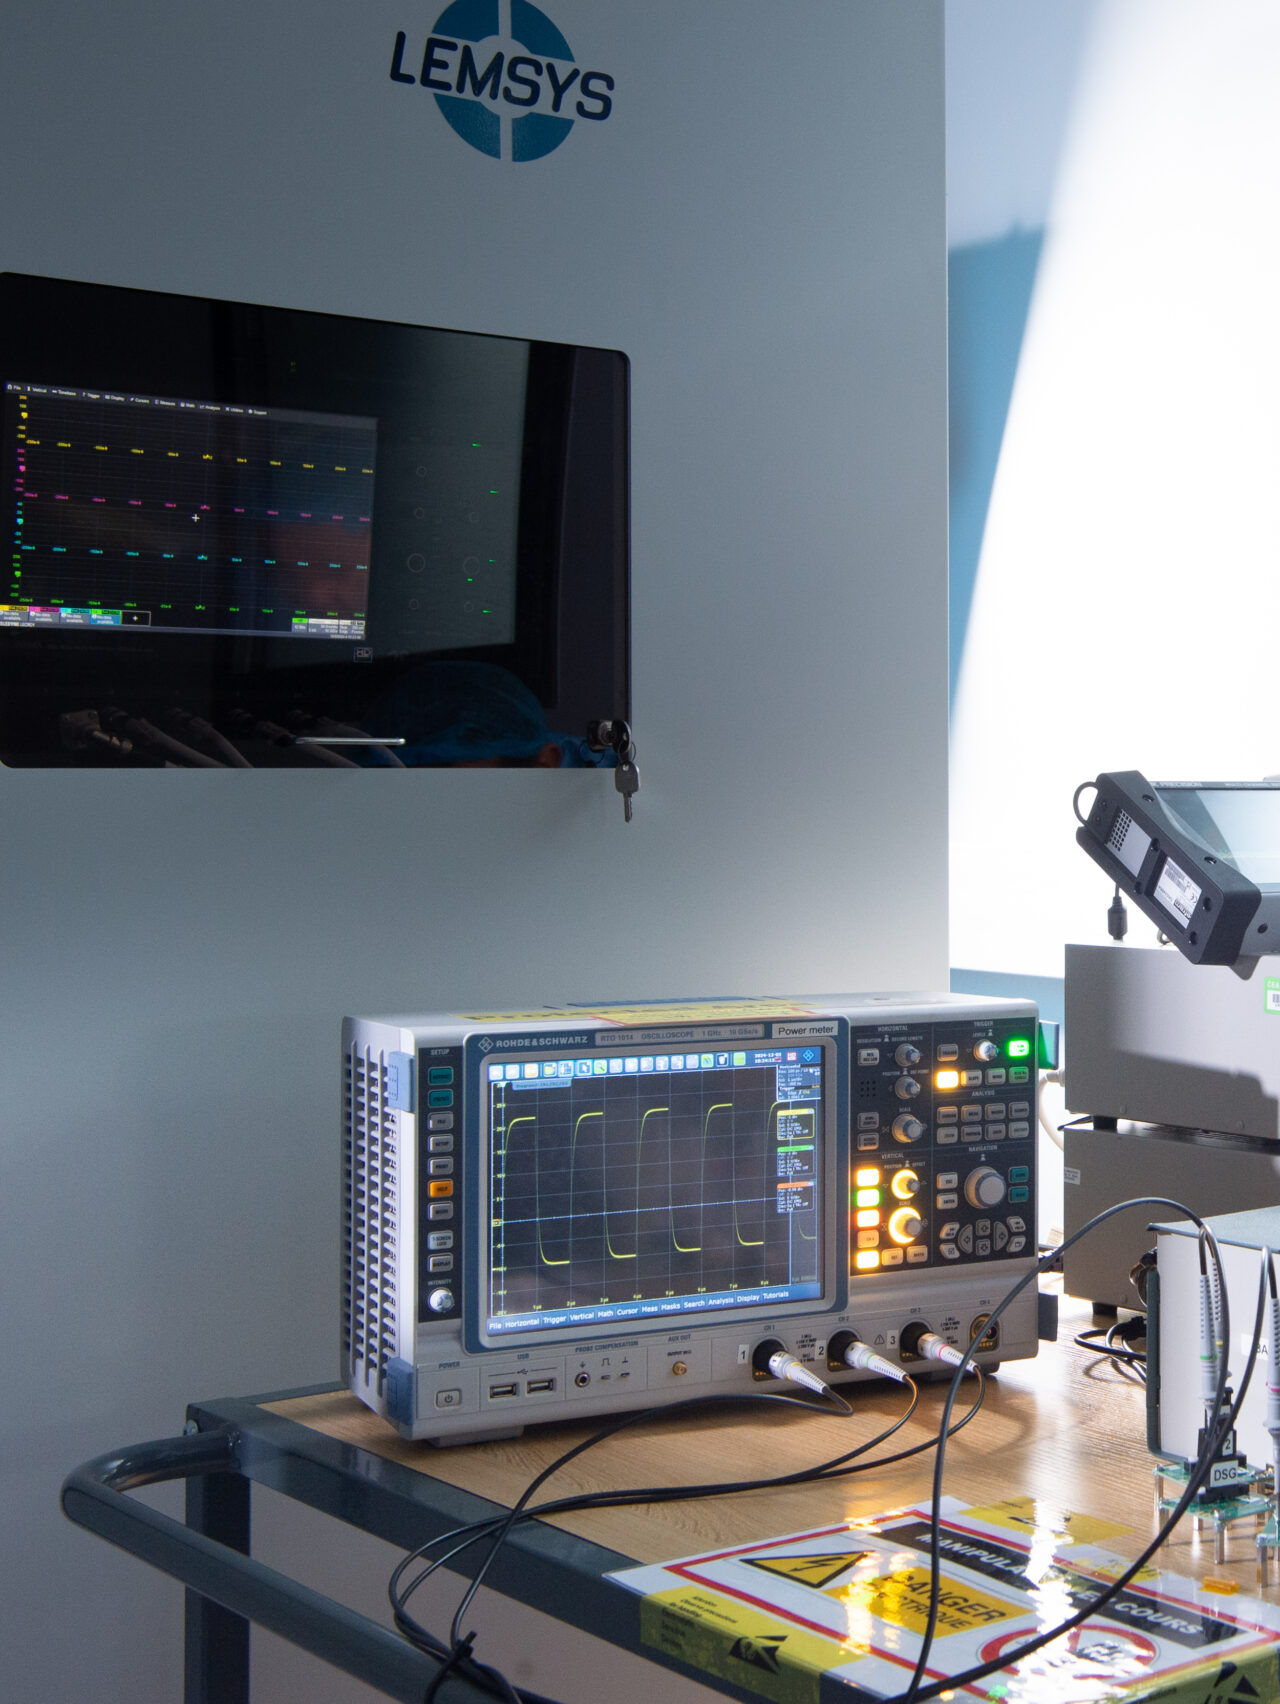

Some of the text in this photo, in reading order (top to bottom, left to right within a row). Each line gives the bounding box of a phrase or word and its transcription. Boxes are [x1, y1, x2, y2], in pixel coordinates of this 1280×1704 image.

[389, 30, 615, 121] LEMSYS
[641, 1030, 695, 1040] OSCILLOSCOPE
[778, 1025, 834, 1036] Power meter
[496, 1036, 588, 1048] ROHDE&SCHWARZ
[505, 1319, 540, 1328] Horizontal
[543, 1316, 567, 1325] Trigger
[570, 1312, 595, 1321] Vertical
[616, 1308, 638, 1316] Cursor
[641, 1305, 658, 1313] Meas
[683, 1300, 706, 1308] Search
[708, 1298, 734, 1307] Analysis
[737, 1294, 760, 1303] Display
[762, 1291, 789, 1299] Tutorials
[890, 1335, 896, 1345] 3
[818, 1345, 825, 1356] 2
[1225, 1438, 1231, 1450] 2
[1213, 1467, 1237, 1482] DSG
[1115, 1601, 1205, 1634] COURS
